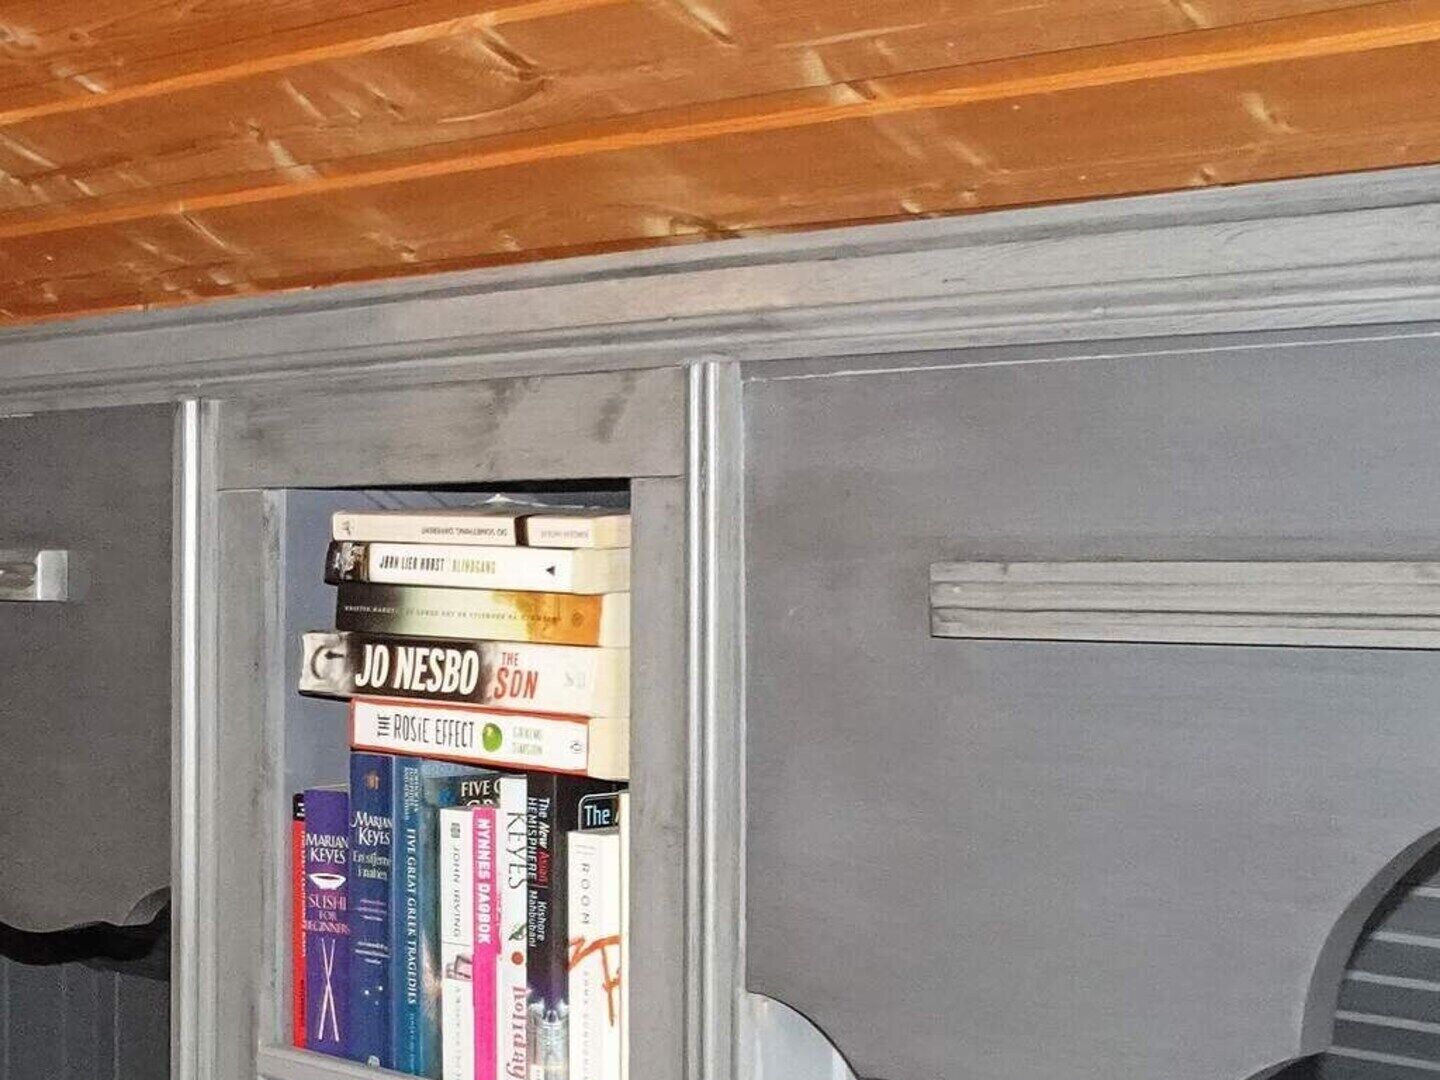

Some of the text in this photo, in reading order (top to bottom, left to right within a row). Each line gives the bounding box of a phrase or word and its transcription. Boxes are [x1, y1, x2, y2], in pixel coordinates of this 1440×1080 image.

[401, 556, 419, 570] LIER
[420, 557, 445, 572] HORST
[355, 644, 479, 695] JO NESBO
[501, 651, 519, 666] THE
[493, 667, 539, 700] SON
[377, 713, 391, 738] THE
[435, 717, 475, 750] EFFECT
[461, 780, 491, 797] FIVE
[350, 811, 393, 828] MARIAN
[539, 797, 550, 818] The
[584, 804, 610, 826] The
[305, 833, 349, 849] MARIAN
[358, 826, 391, 846] KEYES
[407, 828, 417, 853] FIVE
[477, 819, 491, 877] NYNNES
[506, 812, 528, 889] KEYES
[527, 797, 538, 880] HEMISPHERE
[539, 821, 550, 849] New
[310, 847, 346, 864] KEYES
[407, 857, 417, 896] GREAT
[453, 846, 462, 937] JOHN IRVING
[580, 862, 591, 925] ROOM
[308, 893, 347, 911] SUSHI
[319, 910, 337, 922] FOR
[407, 898, 417, 937] GREEK
[477, 882, 491, 944] DAGBOK
[528, 890, 538, 948] Mahbubani
[537, 901, 548, 942] Kishore
[407, 940, 417, 1005] TRAGEDIES
[507, 985, 527, 1080] holiday
